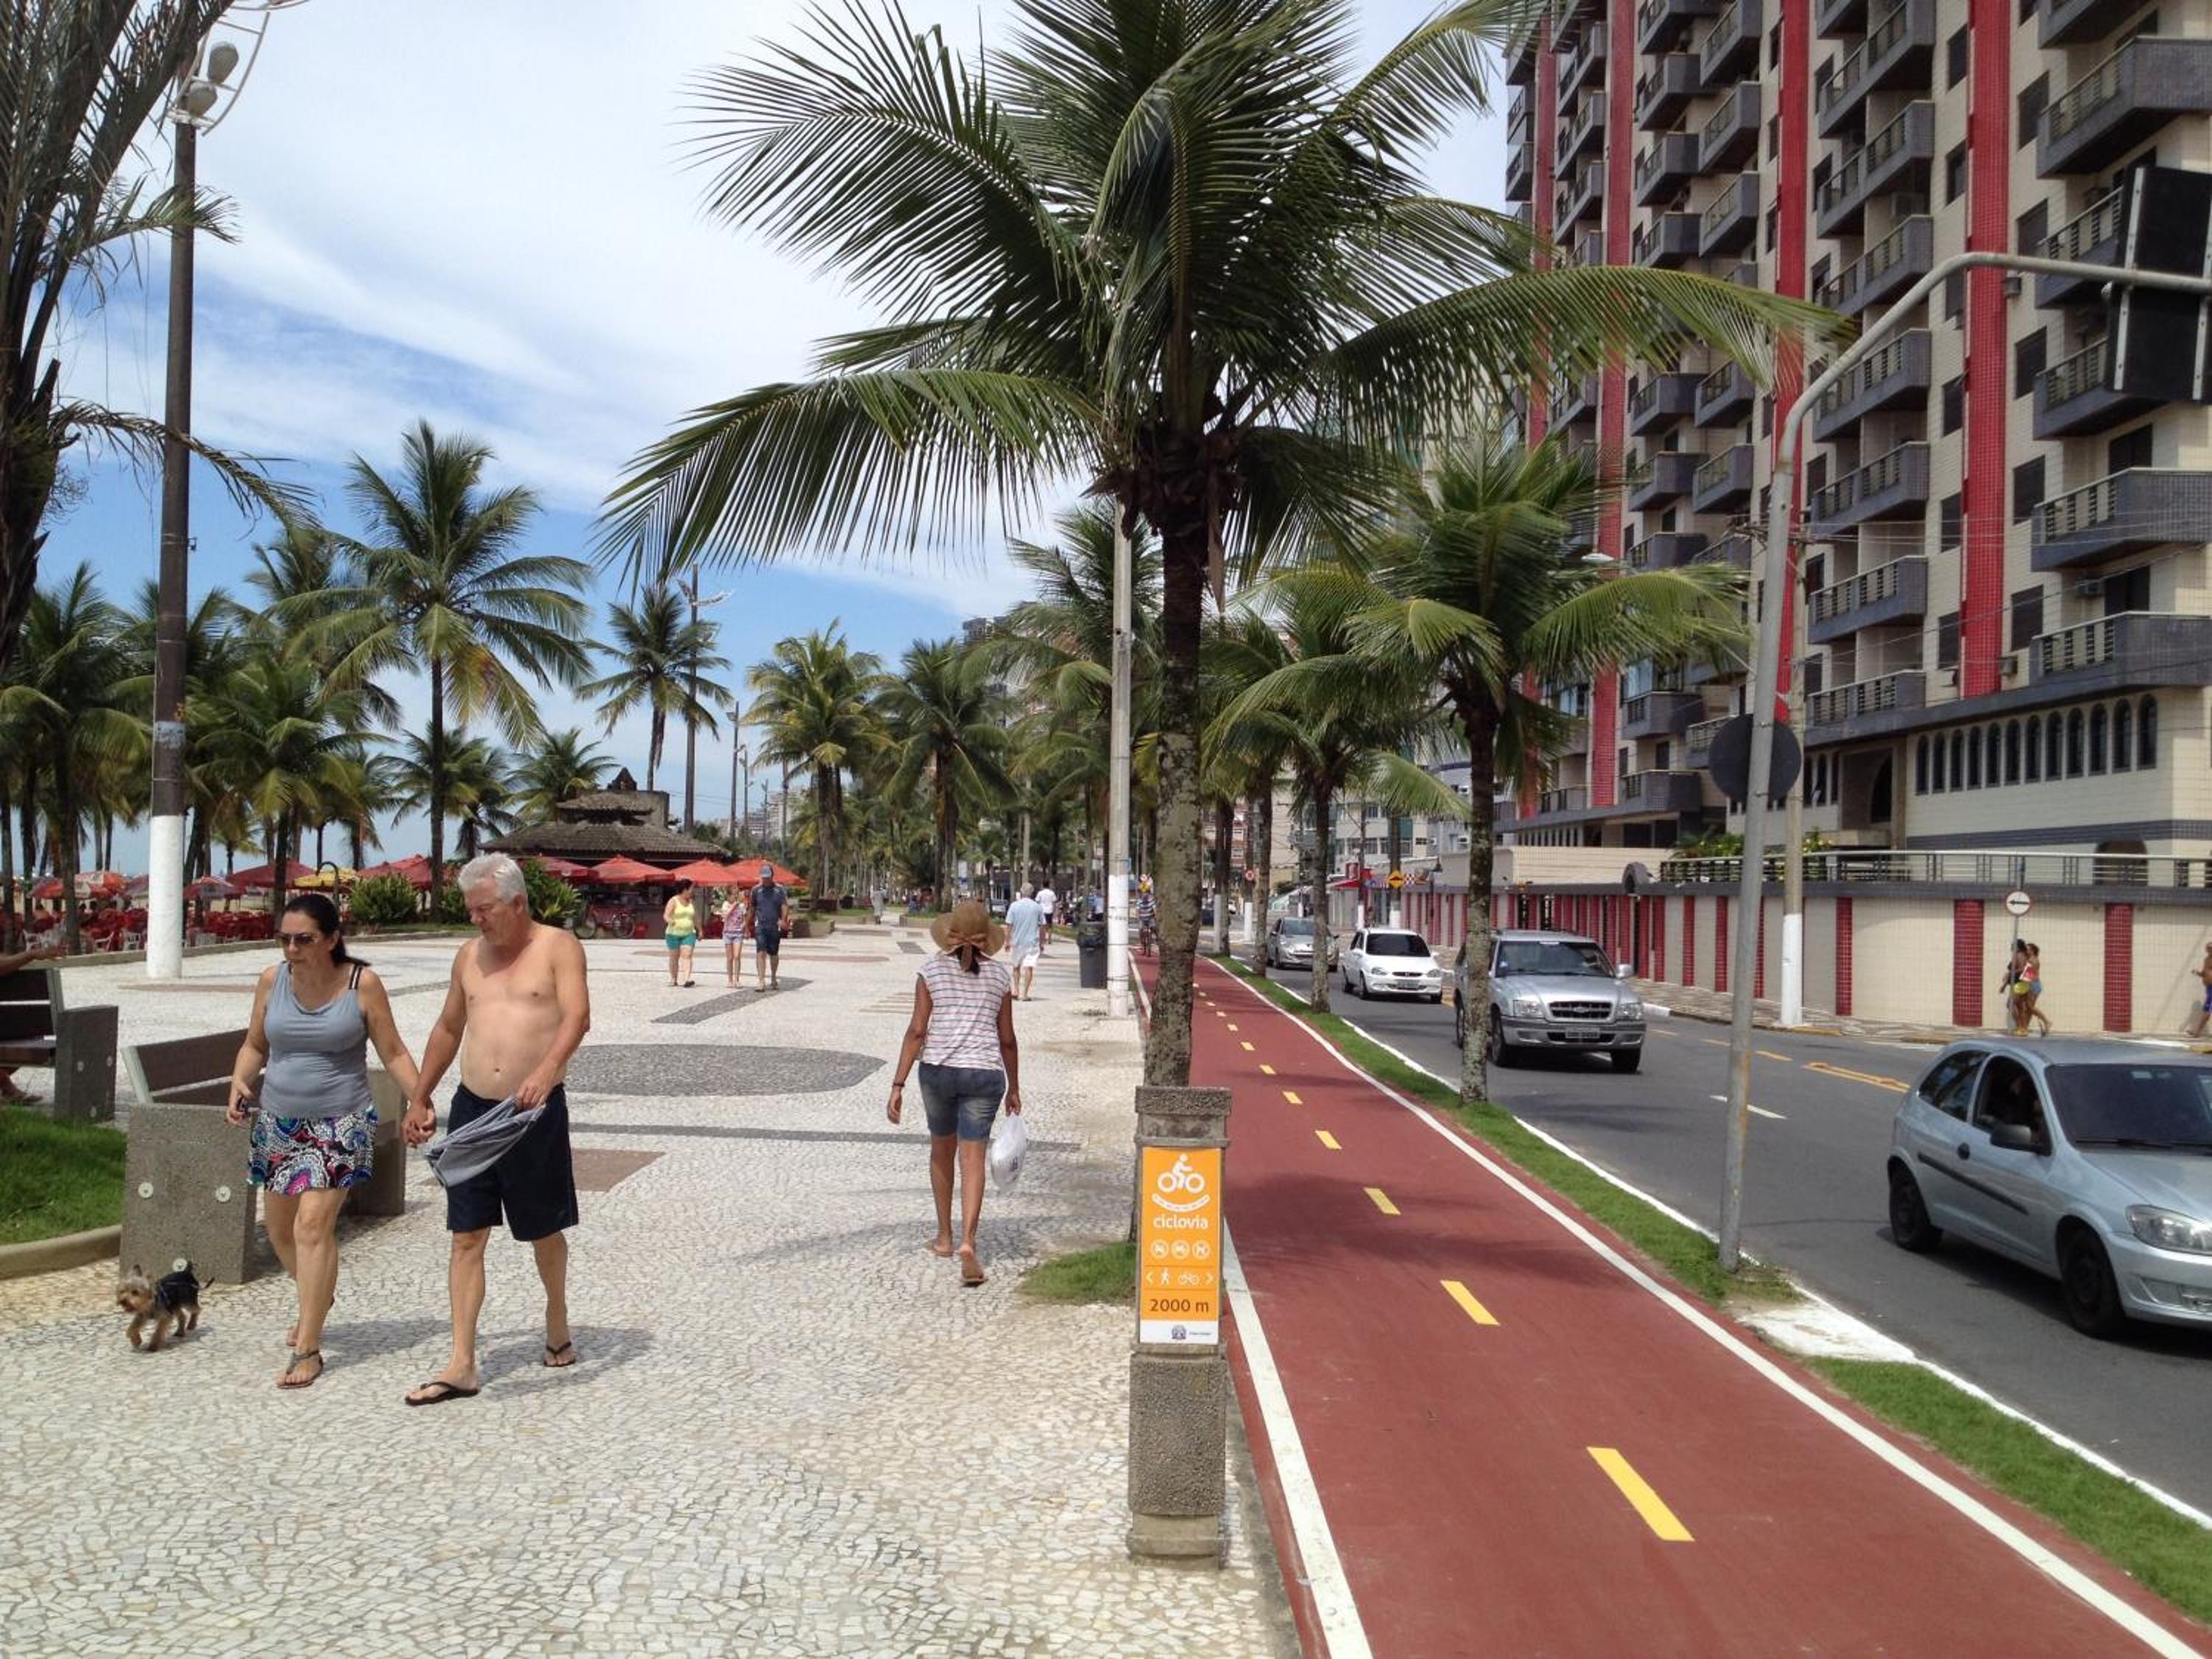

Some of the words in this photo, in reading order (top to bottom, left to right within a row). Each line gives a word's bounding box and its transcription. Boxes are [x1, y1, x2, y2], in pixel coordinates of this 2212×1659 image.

[1153, 1214, 1208, 1229] ciclovia
[1150, 1298, 1191, 1312] 2000
[1195, 1301, 1208, 1312] m
